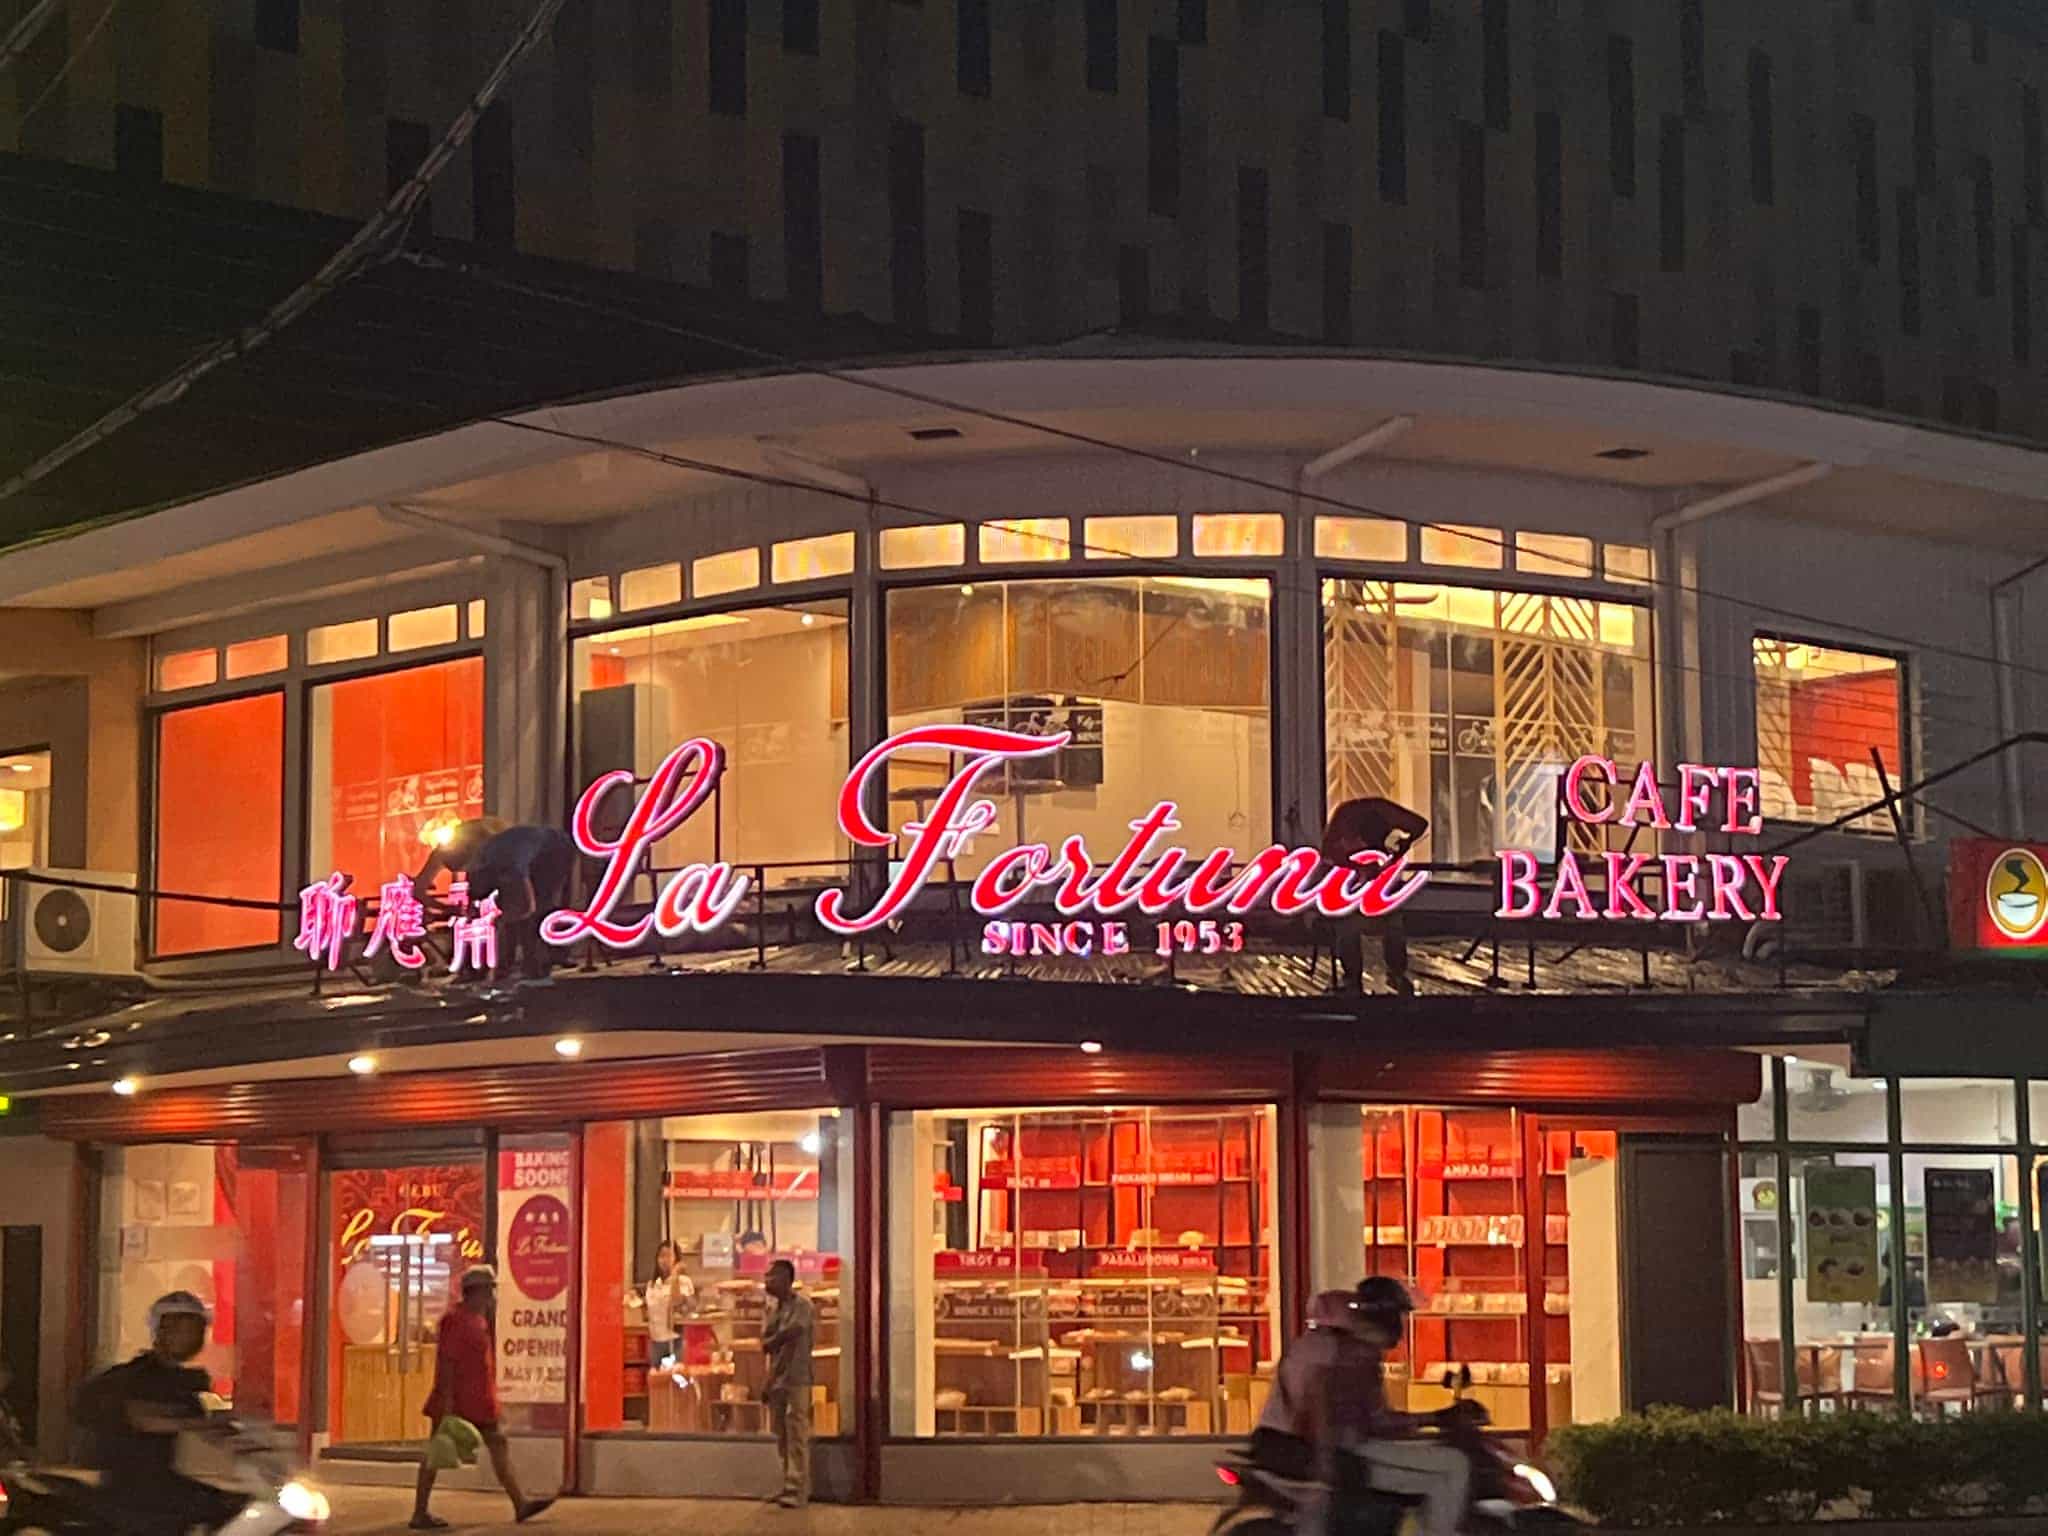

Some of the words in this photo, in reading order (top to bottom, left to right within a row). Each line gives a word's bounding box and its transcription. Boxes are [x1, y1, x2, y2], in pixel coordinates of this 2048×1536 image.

[1565, 755, 1762, 834] CAFE
[540, 738, 750, 947] La
[815, 724, 1432, 934] Fortuna
[1494, 848, 1790, 920] BAKERY
[981, 920, 1129, 956] SINCE
[1156, 920, 1243, 956] 1953
